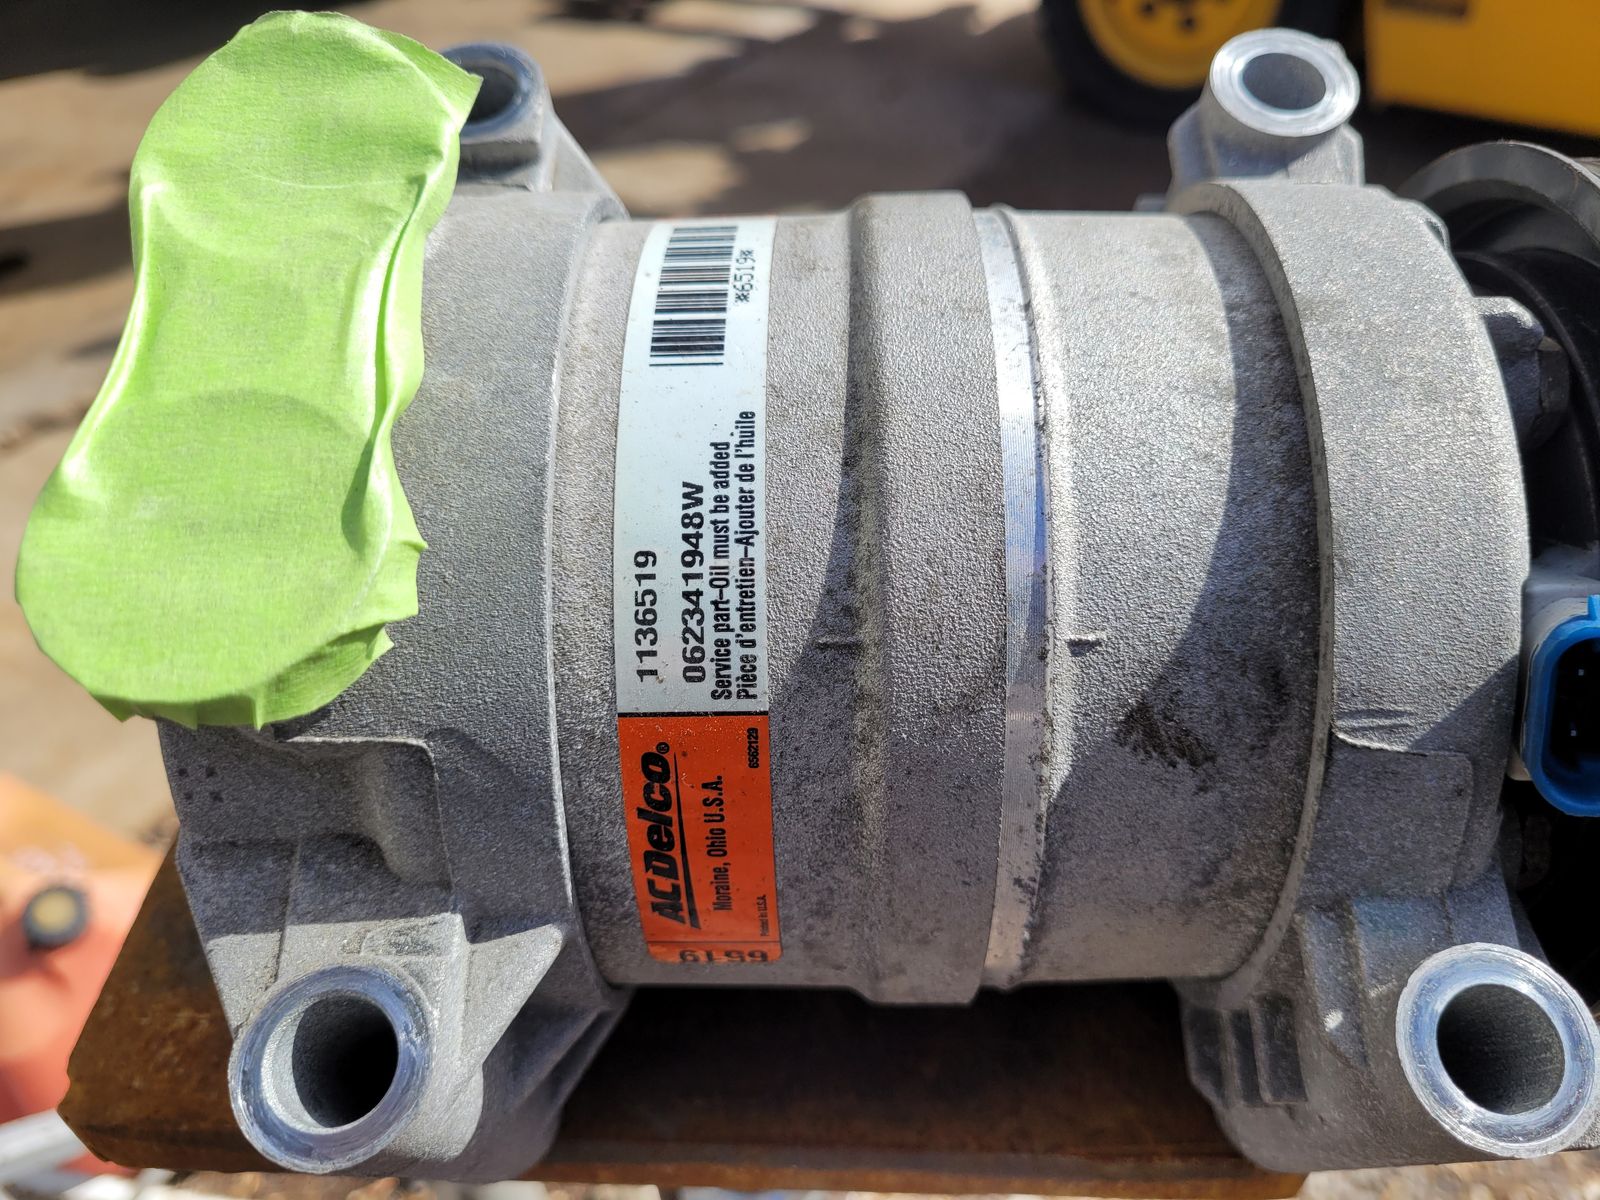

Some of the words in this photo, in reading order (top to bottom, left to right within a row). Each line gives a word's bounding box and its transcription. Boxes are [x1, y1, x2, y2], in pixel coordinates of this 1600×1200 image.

[709, 441, 730, 489] added
[734, 463, 756, 483] de
[709, 494, 730, 514] be
[710, 518, 730, 559] must
[681, 481, 706, 683] 062341948W
[633, 550, 658, 683] 1136519
[710, 638, 733, 700] Service
[736, 654, 758, 700] Pièce
[701, 775, 725, 823] U.S.A.
[705, 827, 728, 857] Ohio
[710, 862, 733, 911] Moraine,
